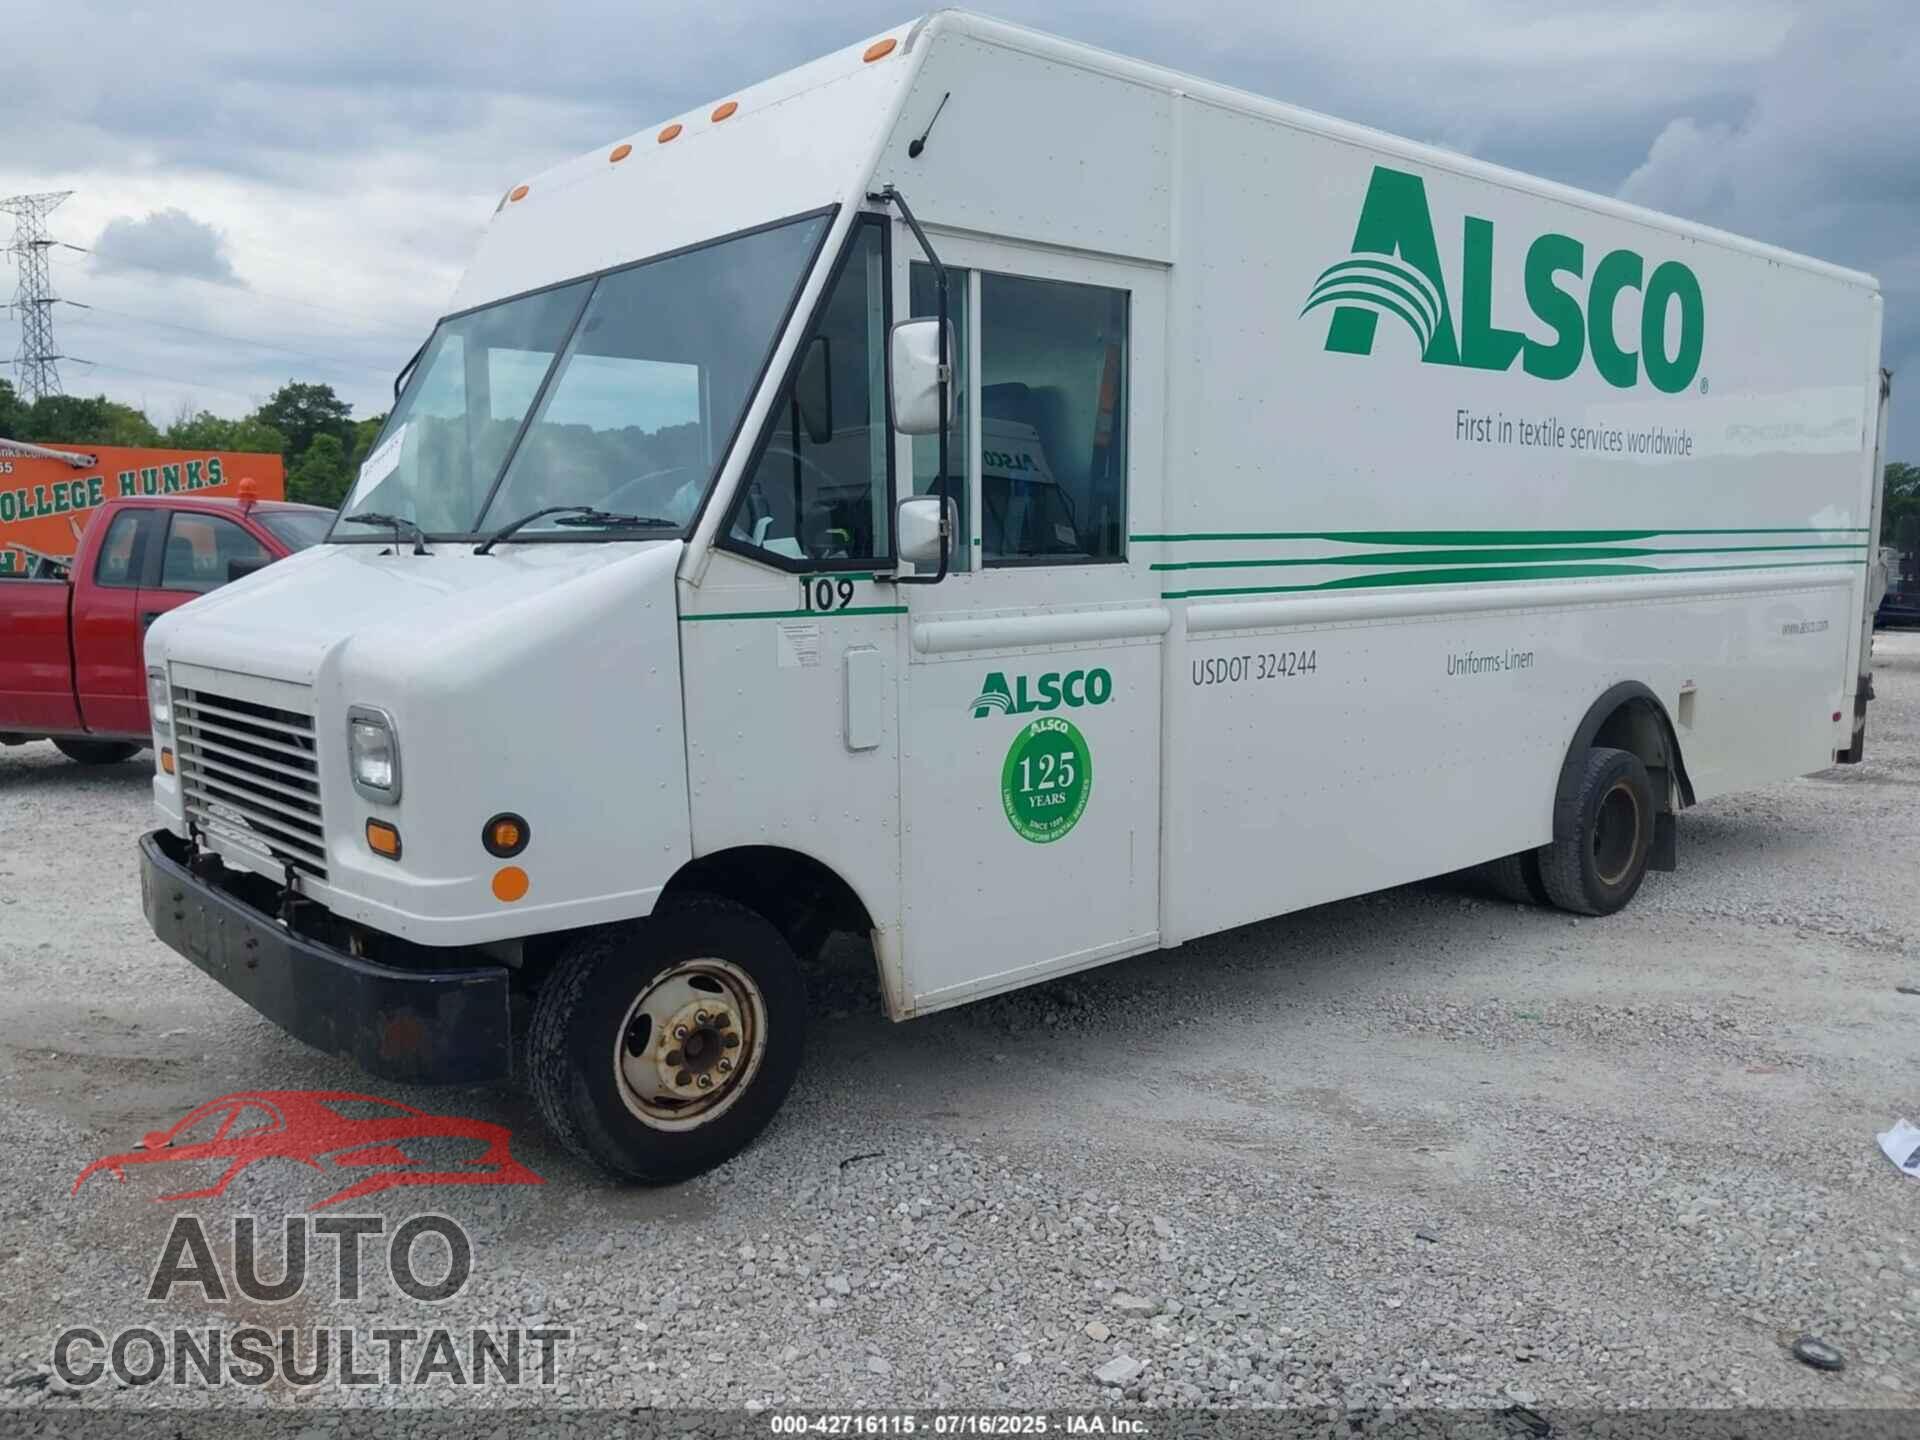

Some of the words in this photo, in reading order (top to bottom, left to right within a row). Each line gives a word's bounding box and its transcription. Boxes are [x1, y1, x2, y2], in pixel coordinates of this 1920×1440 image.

[1300, 165, 1704, 394] ALSCO
[1456, 409, 1492, 442] First
[1497, 412, 1512, 444] in
[1519, 418, 1565, 448] textile
[1570, 422, 1623, 452] services
[1627, 428, 1693, 456] worldwide
[0, 476, 104, 523] OLLEGE
[118, 456, 228, 496] HU.N.K.S.
[802, 578, 854, 611] 109
[1192, 655, 1251, 686] USDOT
[1256, 649, 1317, 680] 324244
[1447, 649, 1534, 676] Uniforms-Linen
[968, 668, 1112, 718] ALSCO
[1030, 719, 1069, 737] ALSCO
[1019, 751, 1075, 793] 125
[1028, 792, 1066, 808] YEARS
